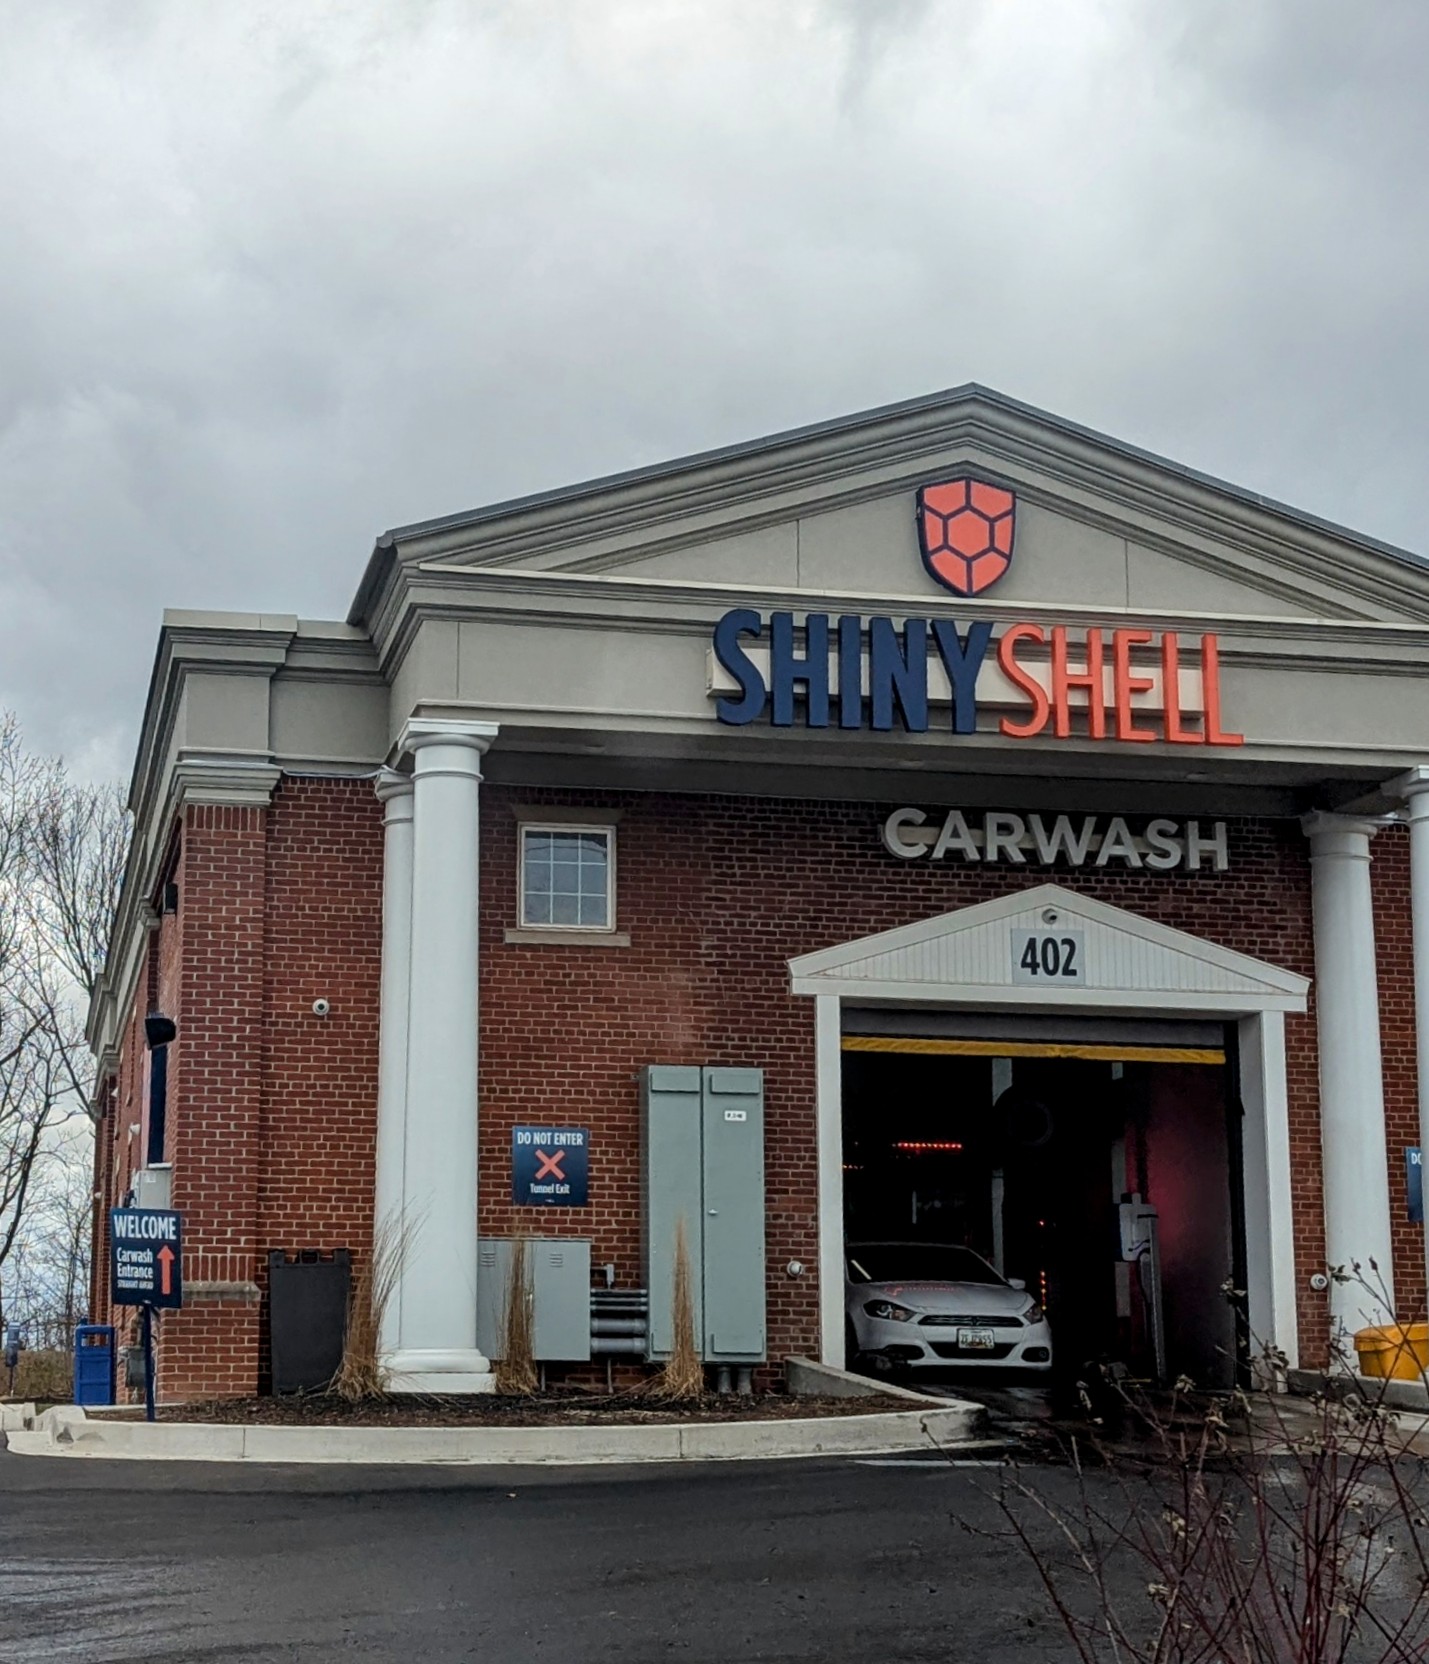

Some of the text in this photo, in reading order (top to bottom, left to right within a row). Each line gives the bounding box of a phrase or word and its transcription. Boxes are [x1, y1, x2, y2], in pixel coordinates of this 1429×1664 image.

[713, 608, 1244, 746] SHINY SHELL
[882, 807, 1229, 871] CARWASH
[1020, 937, 1078, 976] 402
[517, 1131, 583, 1146] DO NOT ENTER
[530, 1183, 570, 1194] Tunnel Exit
[114, 1215, 177, 1240] WELCOME
[116, 1246, 153, 1263] Carwash
[117, 1263, 154, 1279] Entrance
